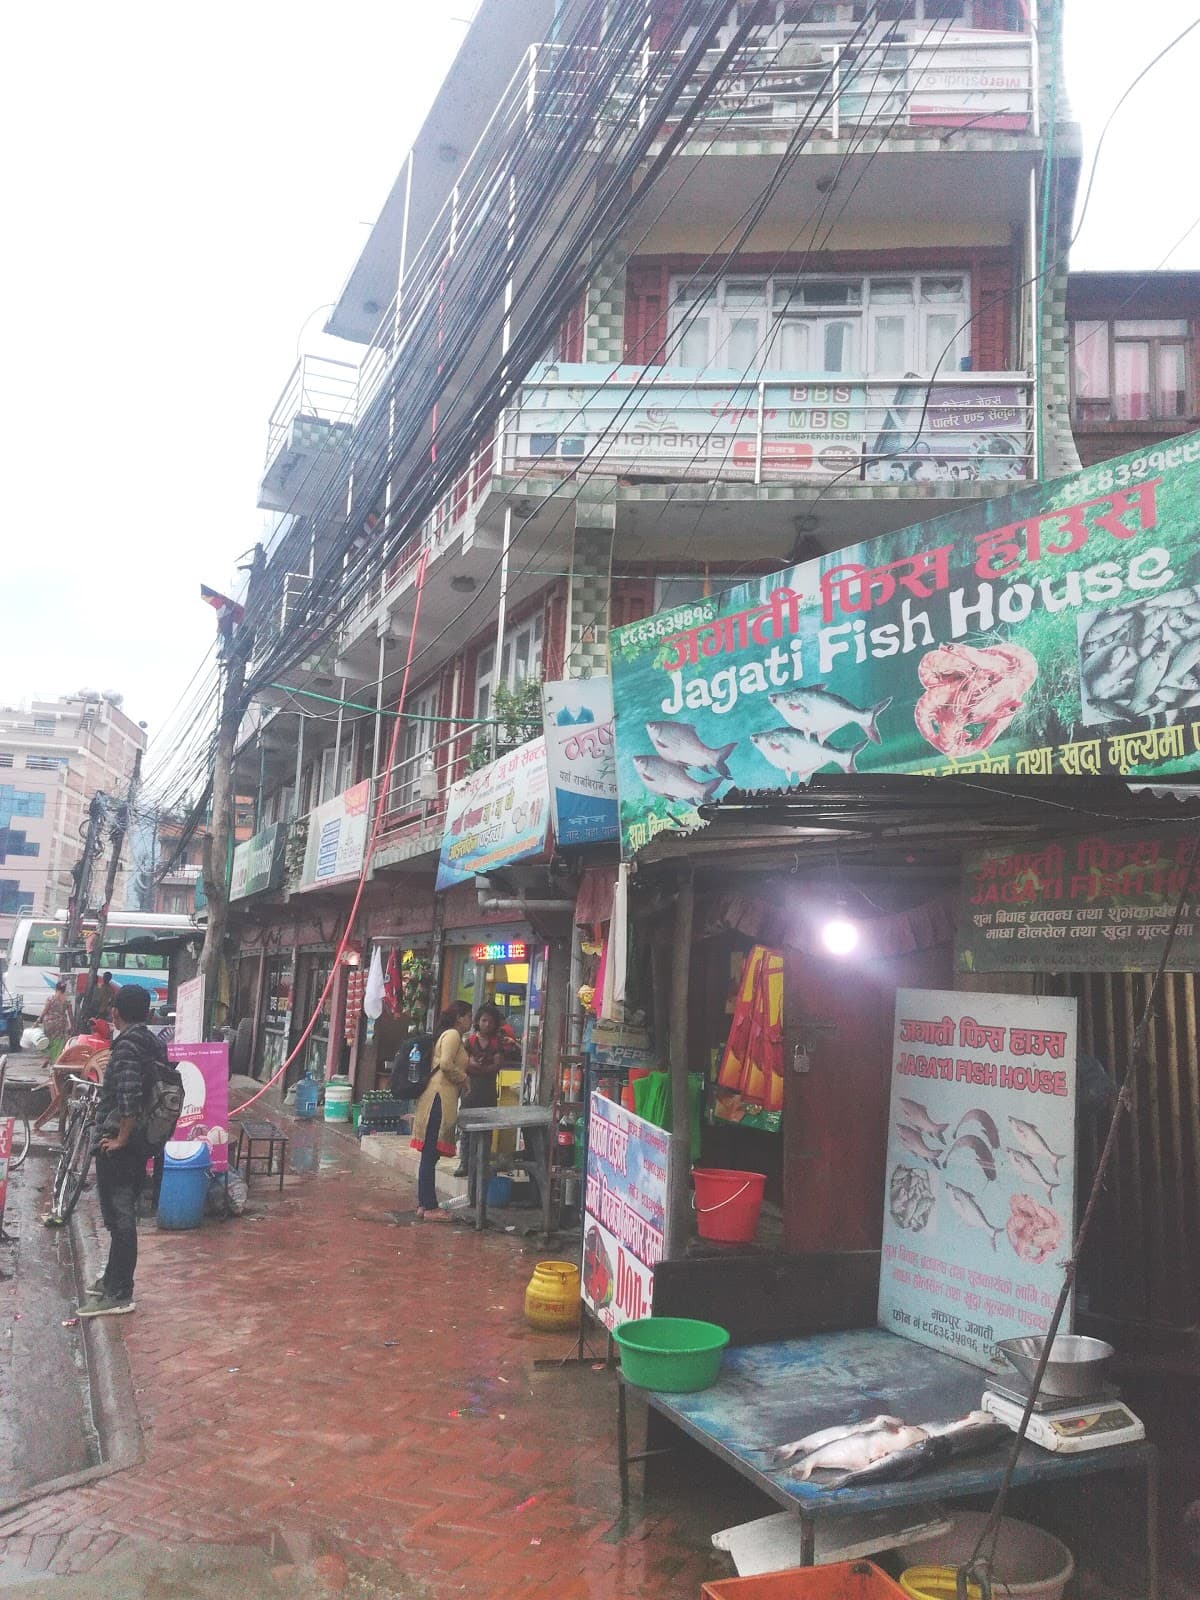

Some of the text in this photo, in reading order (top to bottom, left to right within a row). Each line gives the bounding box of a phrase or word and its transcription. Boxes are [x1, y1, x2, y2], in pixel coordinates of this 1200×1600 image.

[792, 386, 850, 402] BBS
[788, 410, 849, 428] MBS
[661, 477, 1163, 670] जगाती फिस हाउस
[661, 547, 1174, 714] Jagati Fish House
[970, 876, 1064, 905] JAGATI
[1070, 871, 1144, 899] FISH
[1076, 907, 1104, 923] तथा
[1070, 926, 1097, 939] तथा
[901, 1016, 1068, 1059] जगाती फिस हाउस
[896, 1053, 1068, 1096] JAGATI FISH HOUSE
